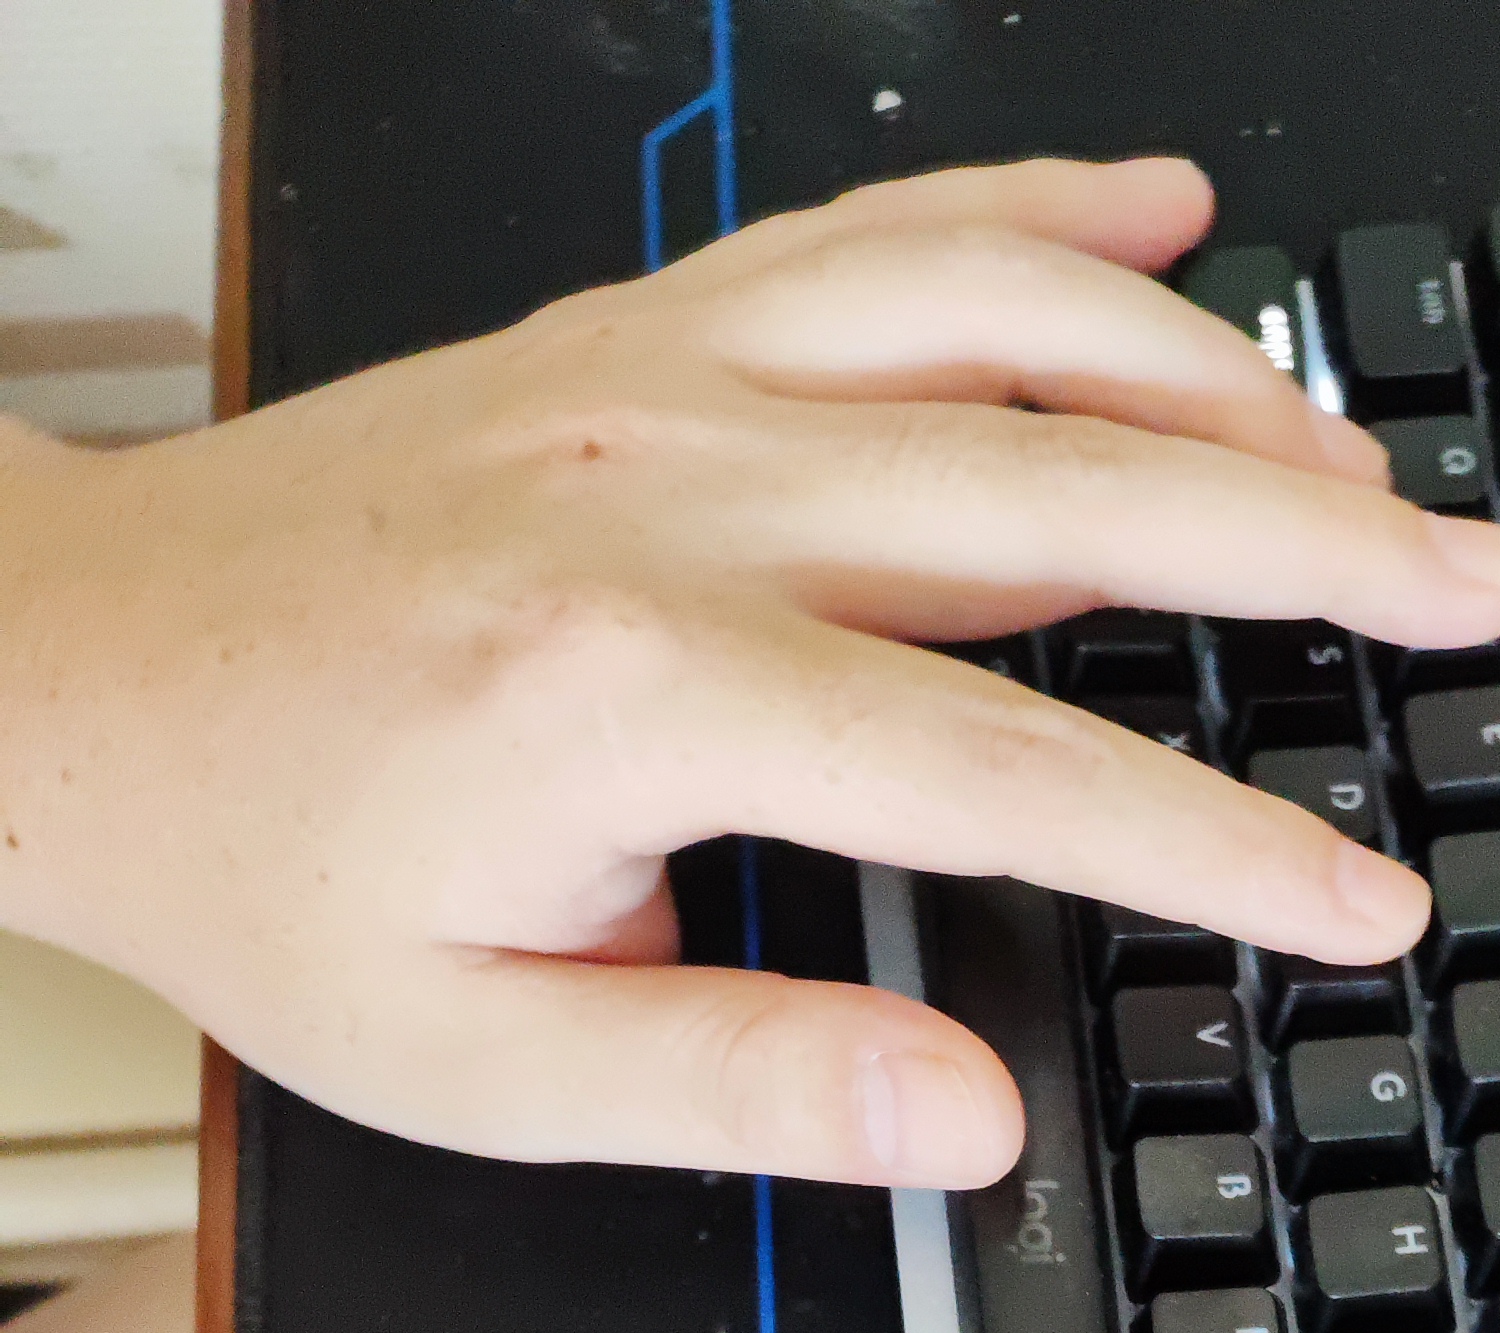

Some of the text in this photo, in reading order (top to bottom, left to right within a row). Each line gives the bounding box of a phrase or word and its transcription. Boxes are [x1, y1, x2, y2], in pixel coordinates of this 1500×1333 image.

[1307, 643, 1344, 665] S
[1329, 784, 1365, 810] D
[1196, 1022, 1231, 1047] V
[1370, 1071, 1407, 1102] G
[1217, 1174, 1252, 1199] B
[1005, 1177, 1065, 1264] logi
[1391, 1225, 1429, 1255] H
